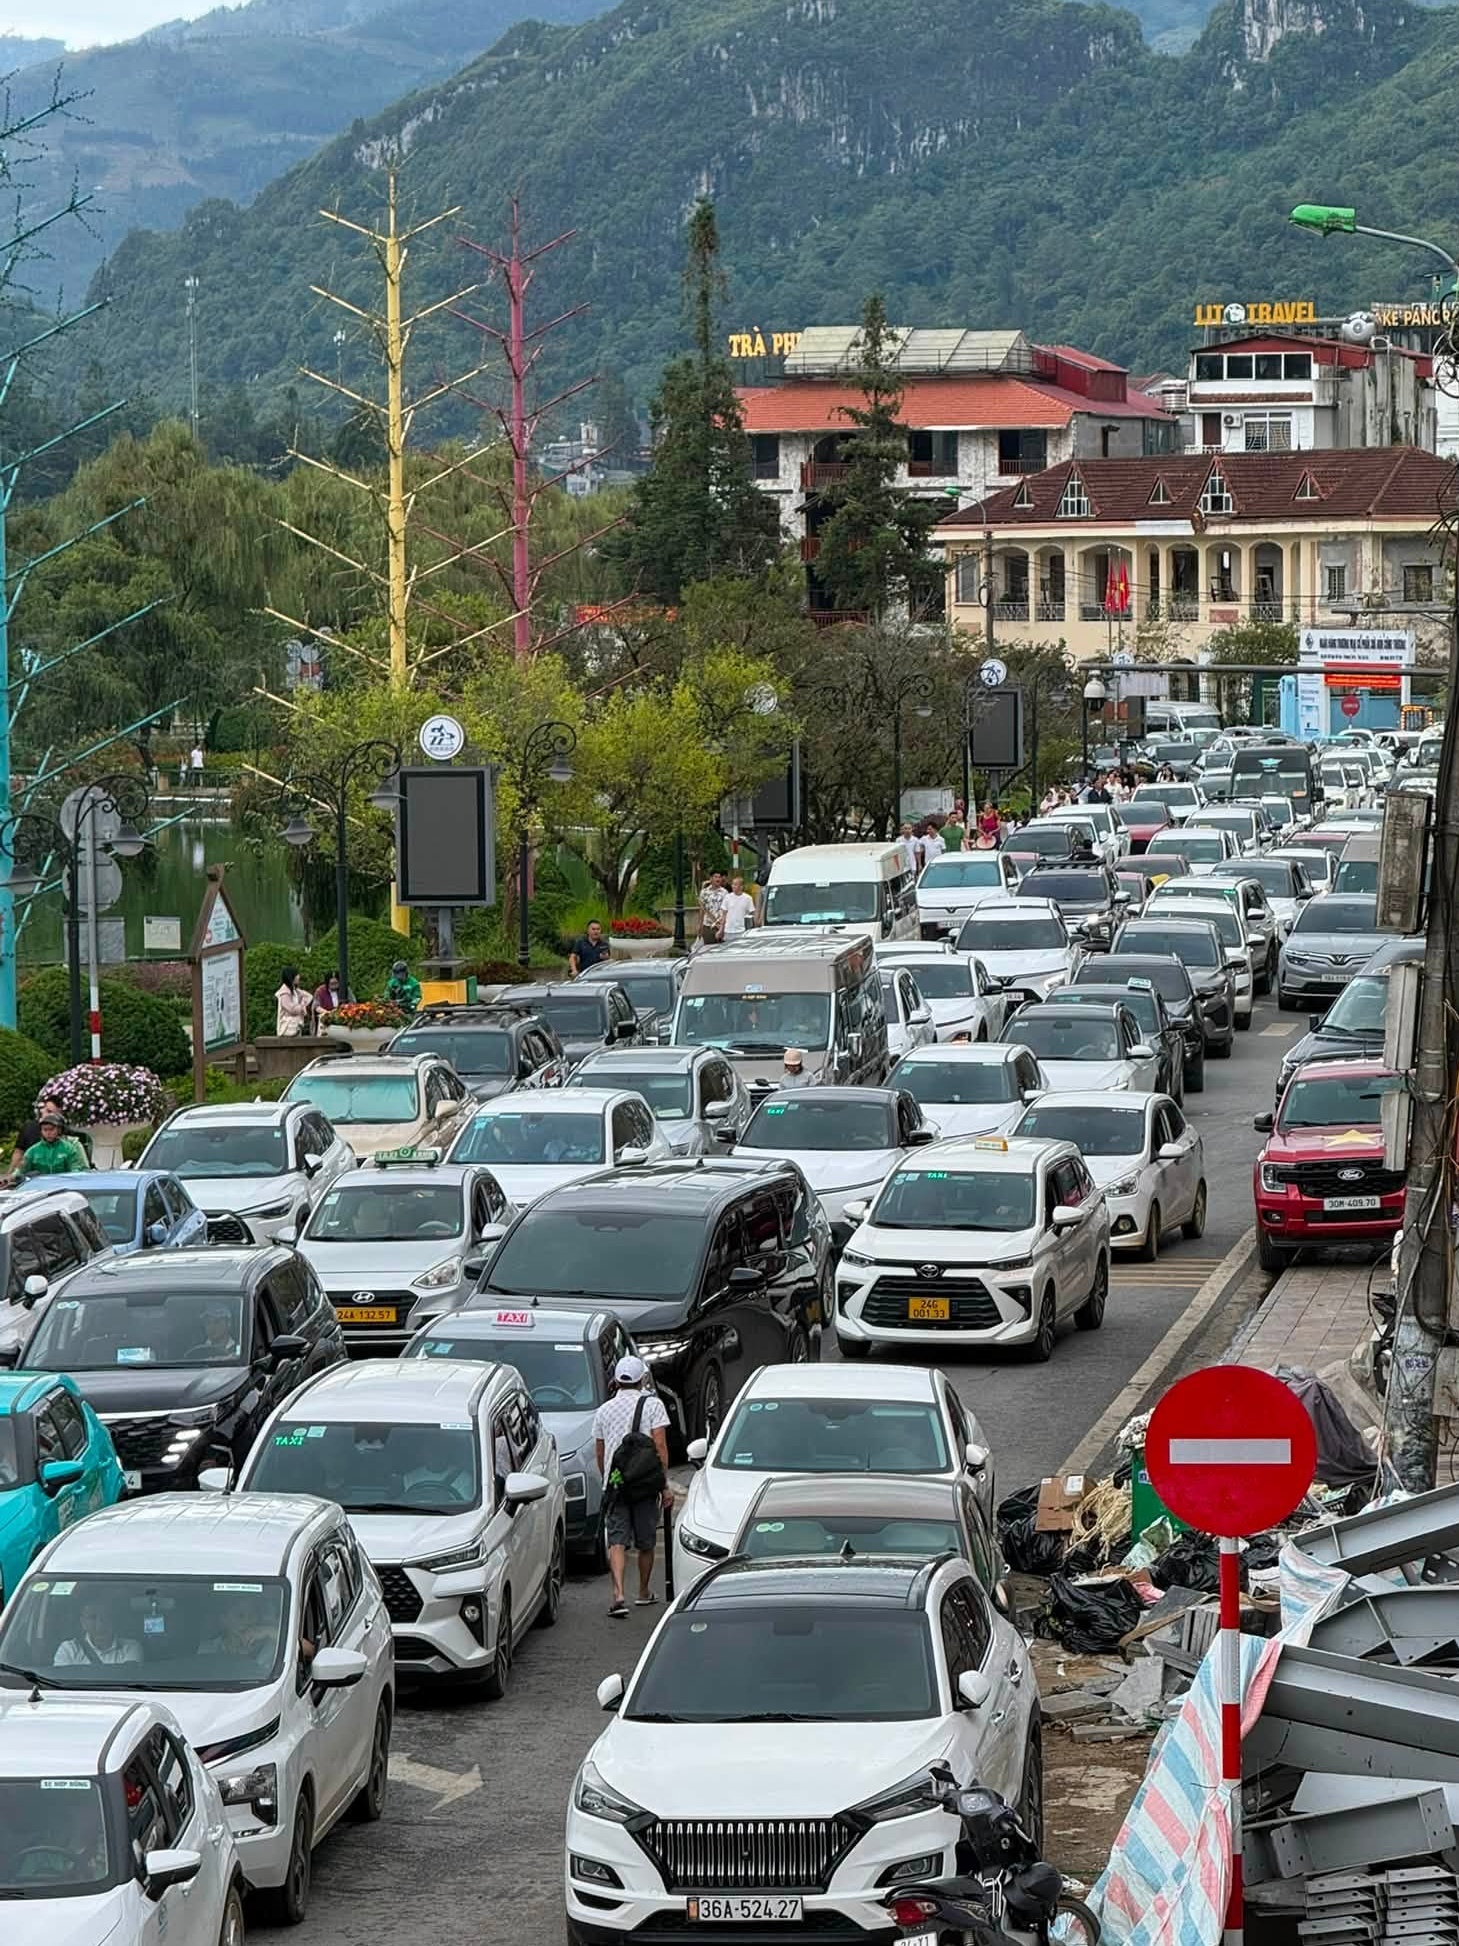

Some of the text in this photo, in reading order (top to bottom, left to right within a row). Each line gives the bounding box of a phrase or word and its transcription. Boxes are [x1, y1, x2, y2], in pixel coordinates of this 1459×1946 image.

[1246, 301, 1318, 324] TRAVEL
[728, 325, 767, 358] TRÀ
[500, 1312, 528, 1323] TAXI
[275, 1436, 304, 1446] TAXI
[701, 1900, 799, 1919] 36A-524.27
